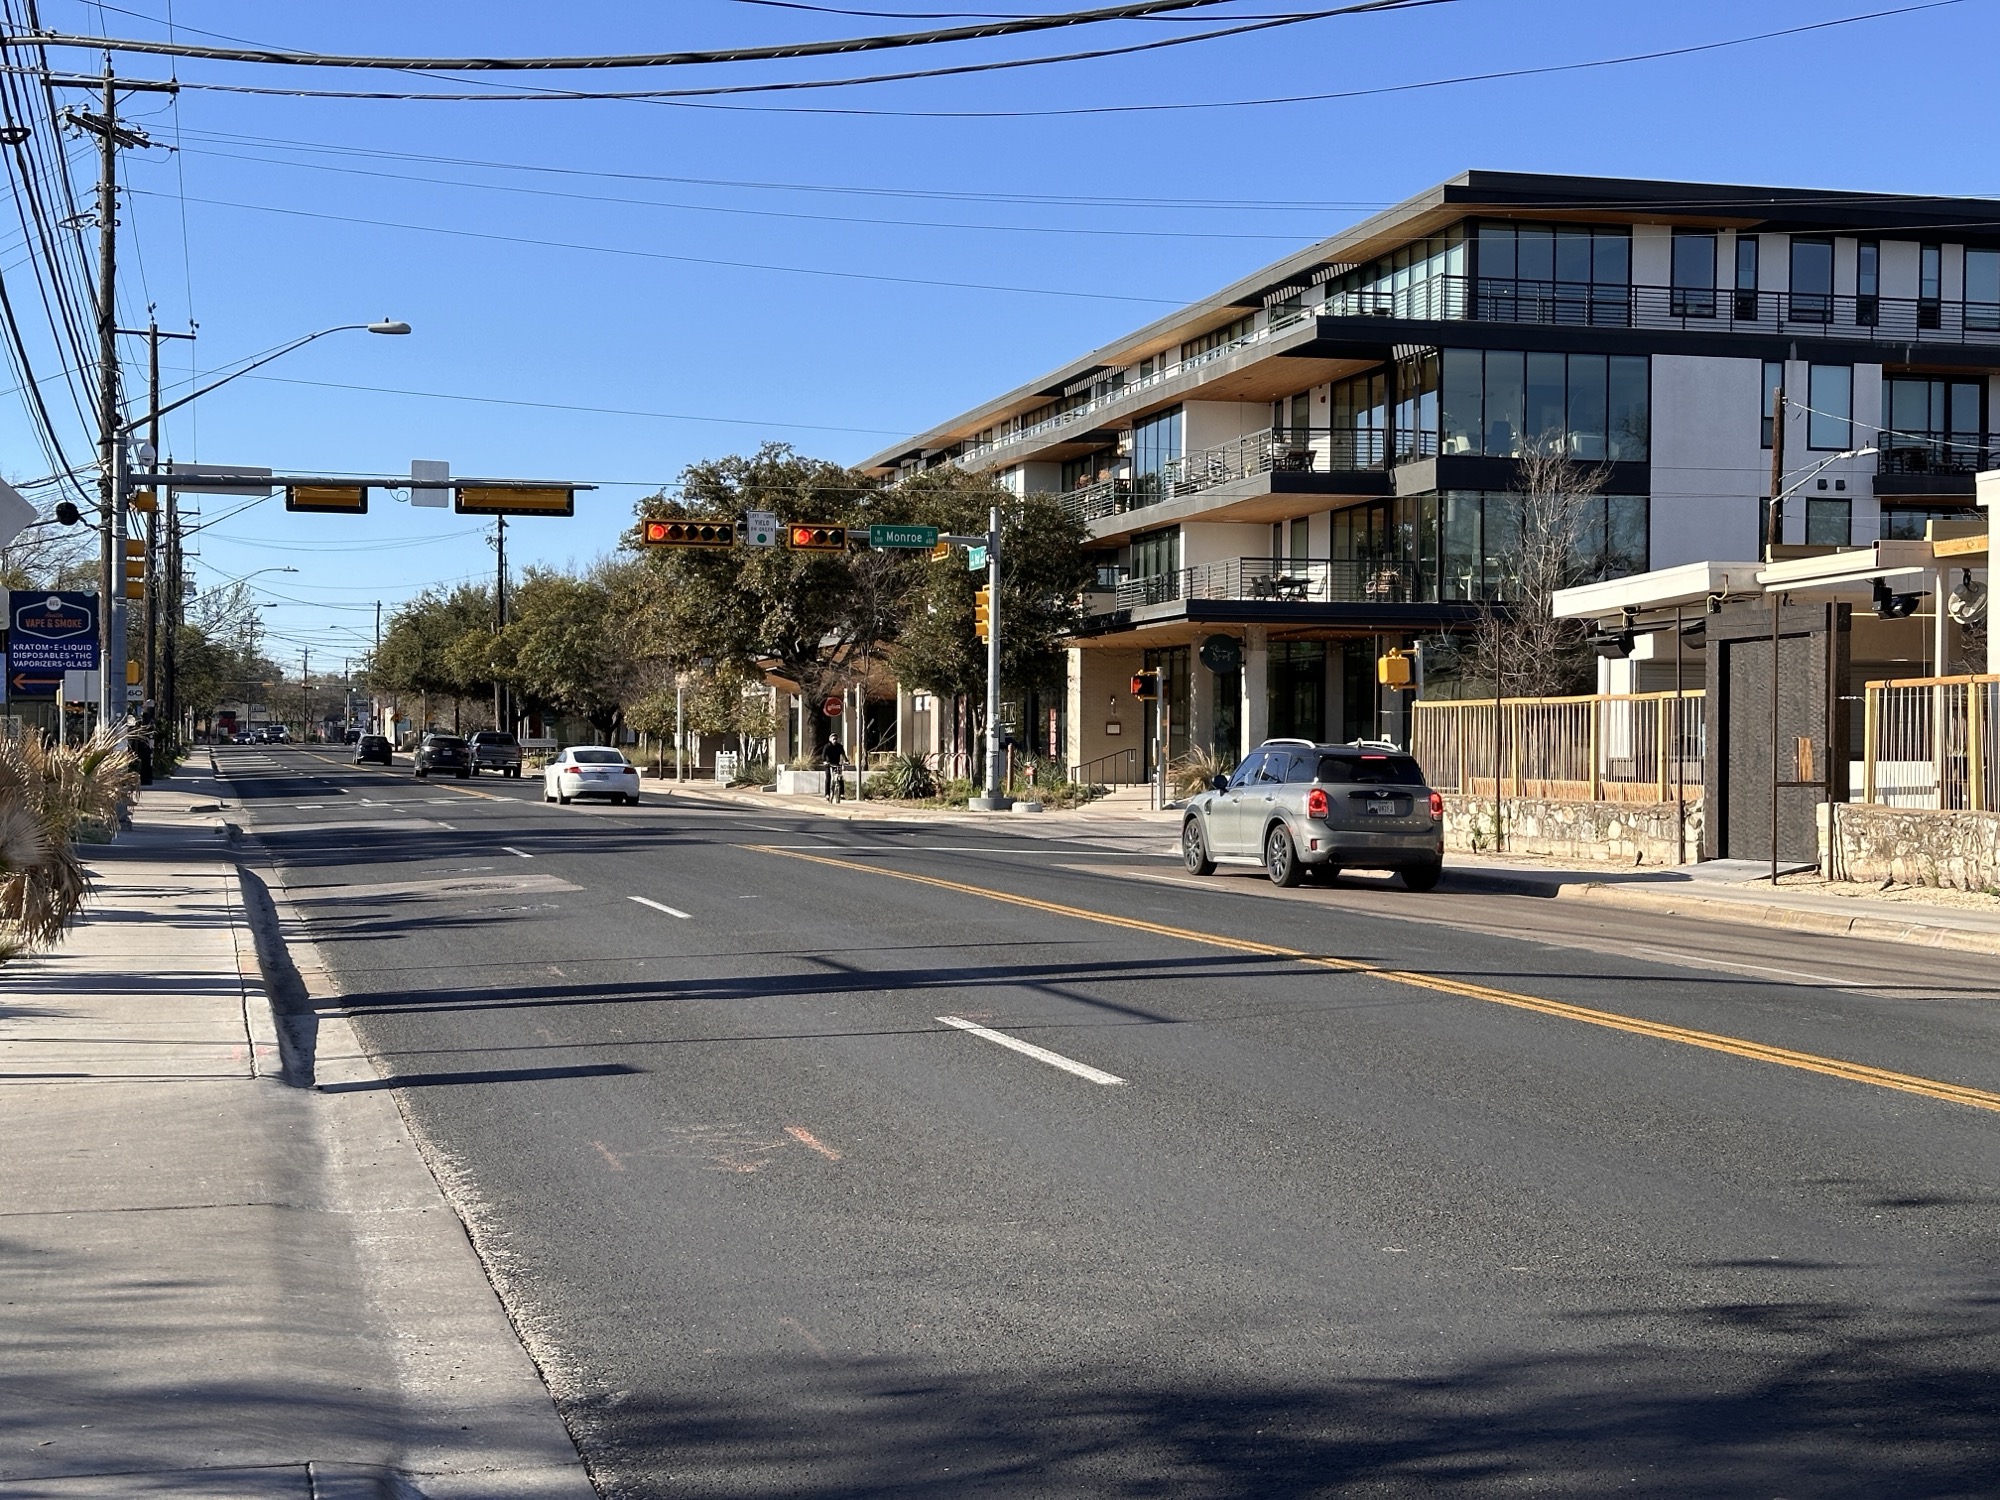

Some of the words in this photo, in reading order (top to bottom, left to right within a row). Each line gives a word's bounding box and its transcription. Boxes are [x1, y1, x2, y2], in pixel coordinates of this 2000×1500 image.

[886, 531, 923, 543] Monroe
[25, 619, 45, 628] VAPE
[47, 619, 53, 628] &
[54, 619, 82, 628] SMOKE
